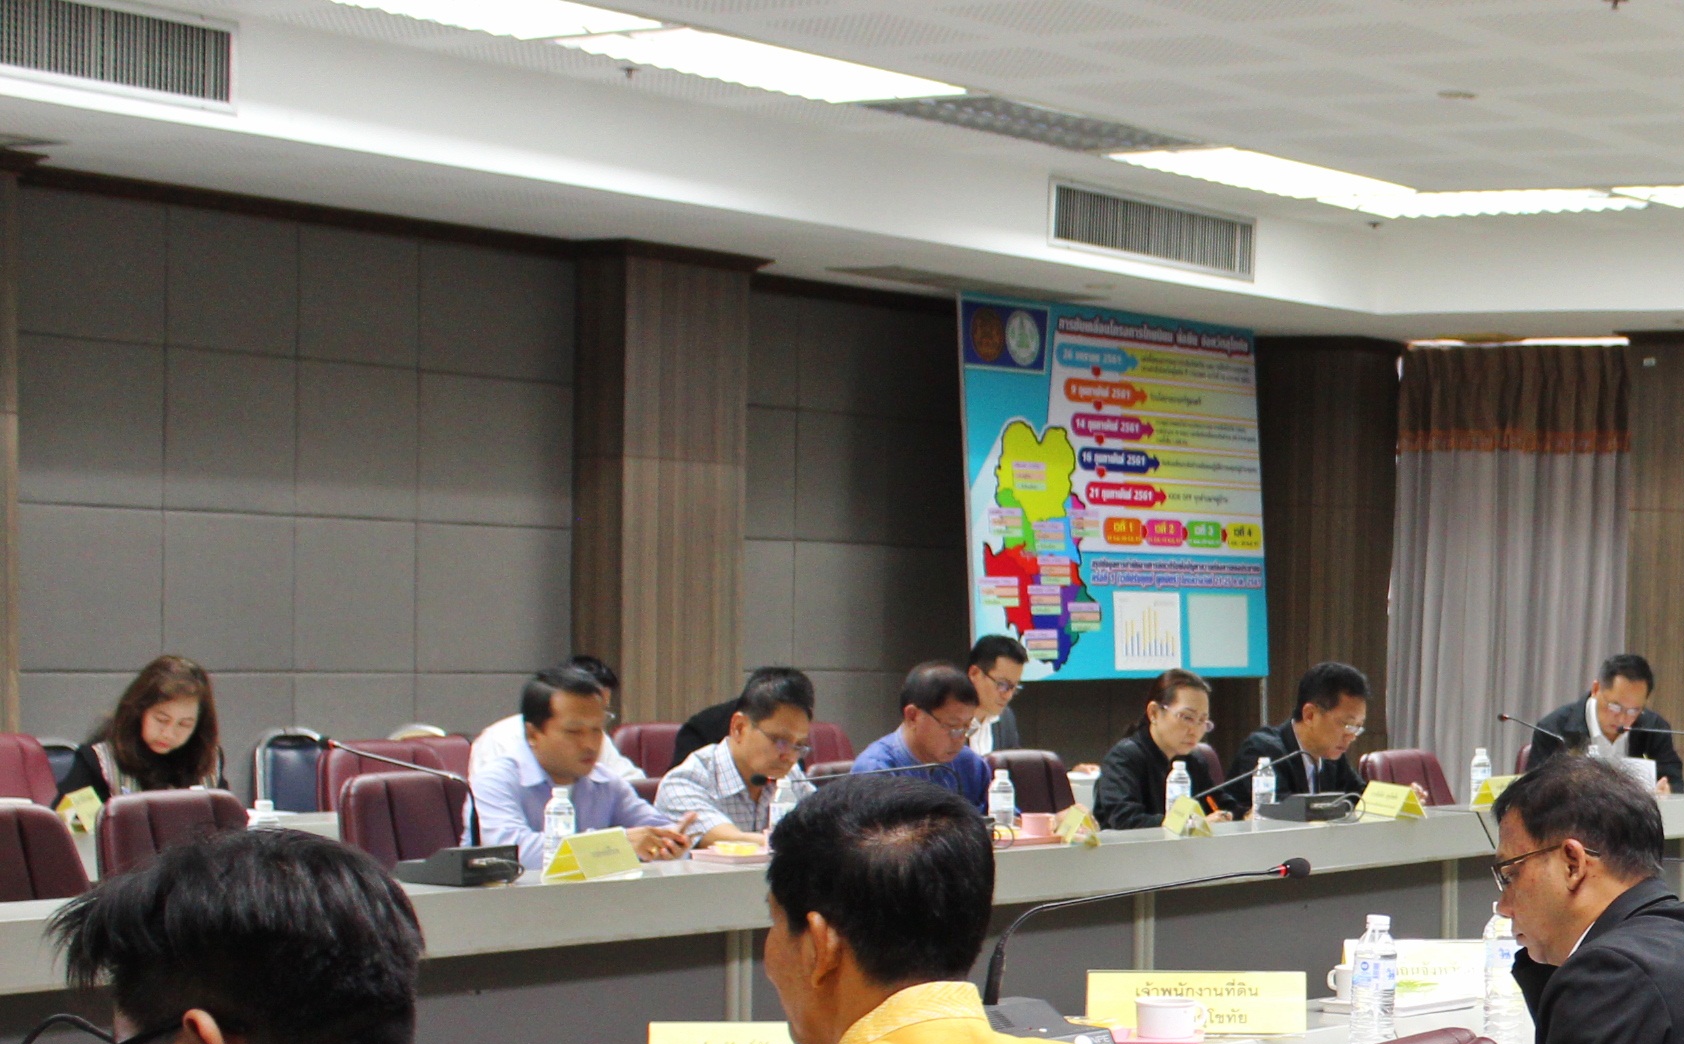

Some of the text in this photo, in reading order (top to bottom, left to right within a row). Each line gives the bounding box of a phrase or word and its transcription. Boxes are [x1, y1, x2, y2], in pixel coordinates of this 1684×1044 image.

[1135, 979, 1259, 998] เจ้าพนักงานที่ดิน
